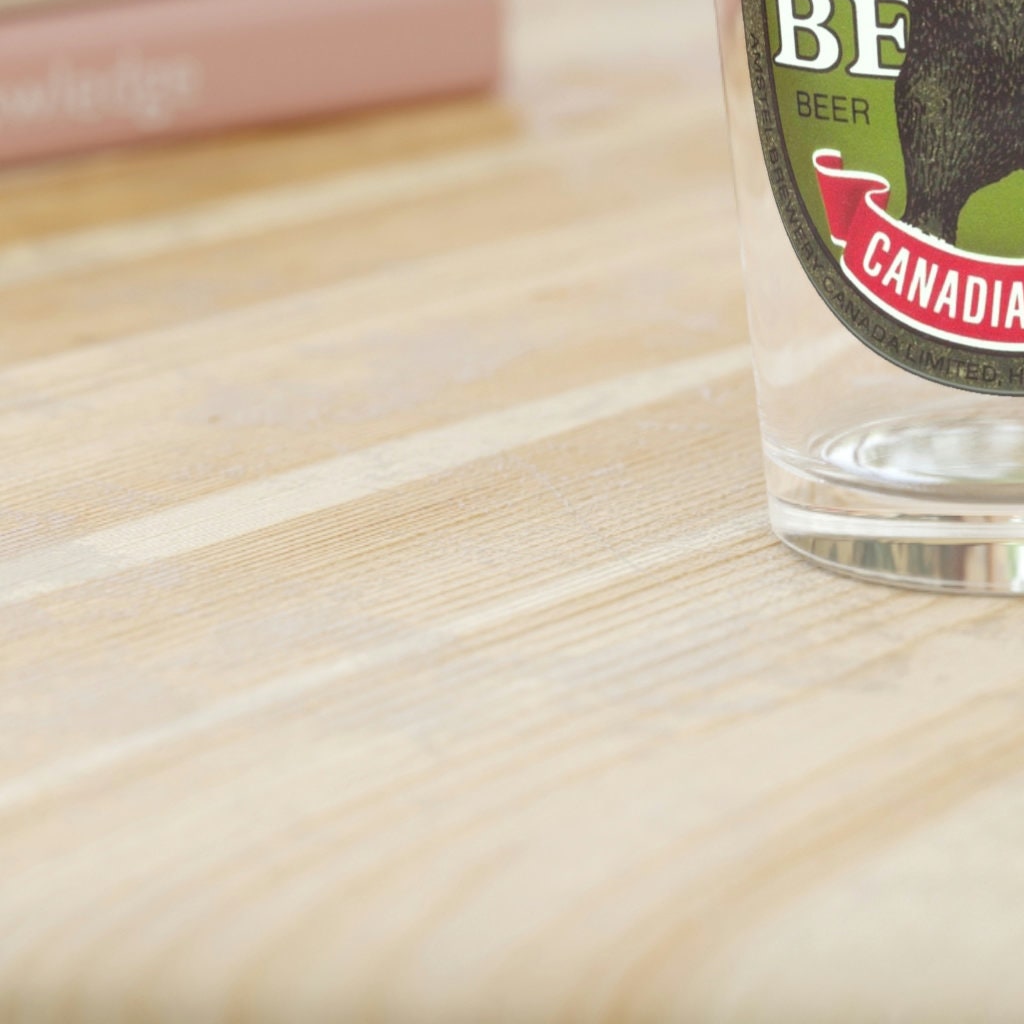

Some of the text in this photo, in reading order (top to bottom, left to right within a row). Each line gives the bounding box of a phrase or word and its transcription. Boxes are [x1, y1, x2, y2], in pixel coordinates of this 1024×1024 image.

[750, 31, 774, 138] AMSTEL
[767, 147, 825, 272] BREWERY
[821, 276, 899, 354] CANADA
[796, 90, 870, 125] BEER
